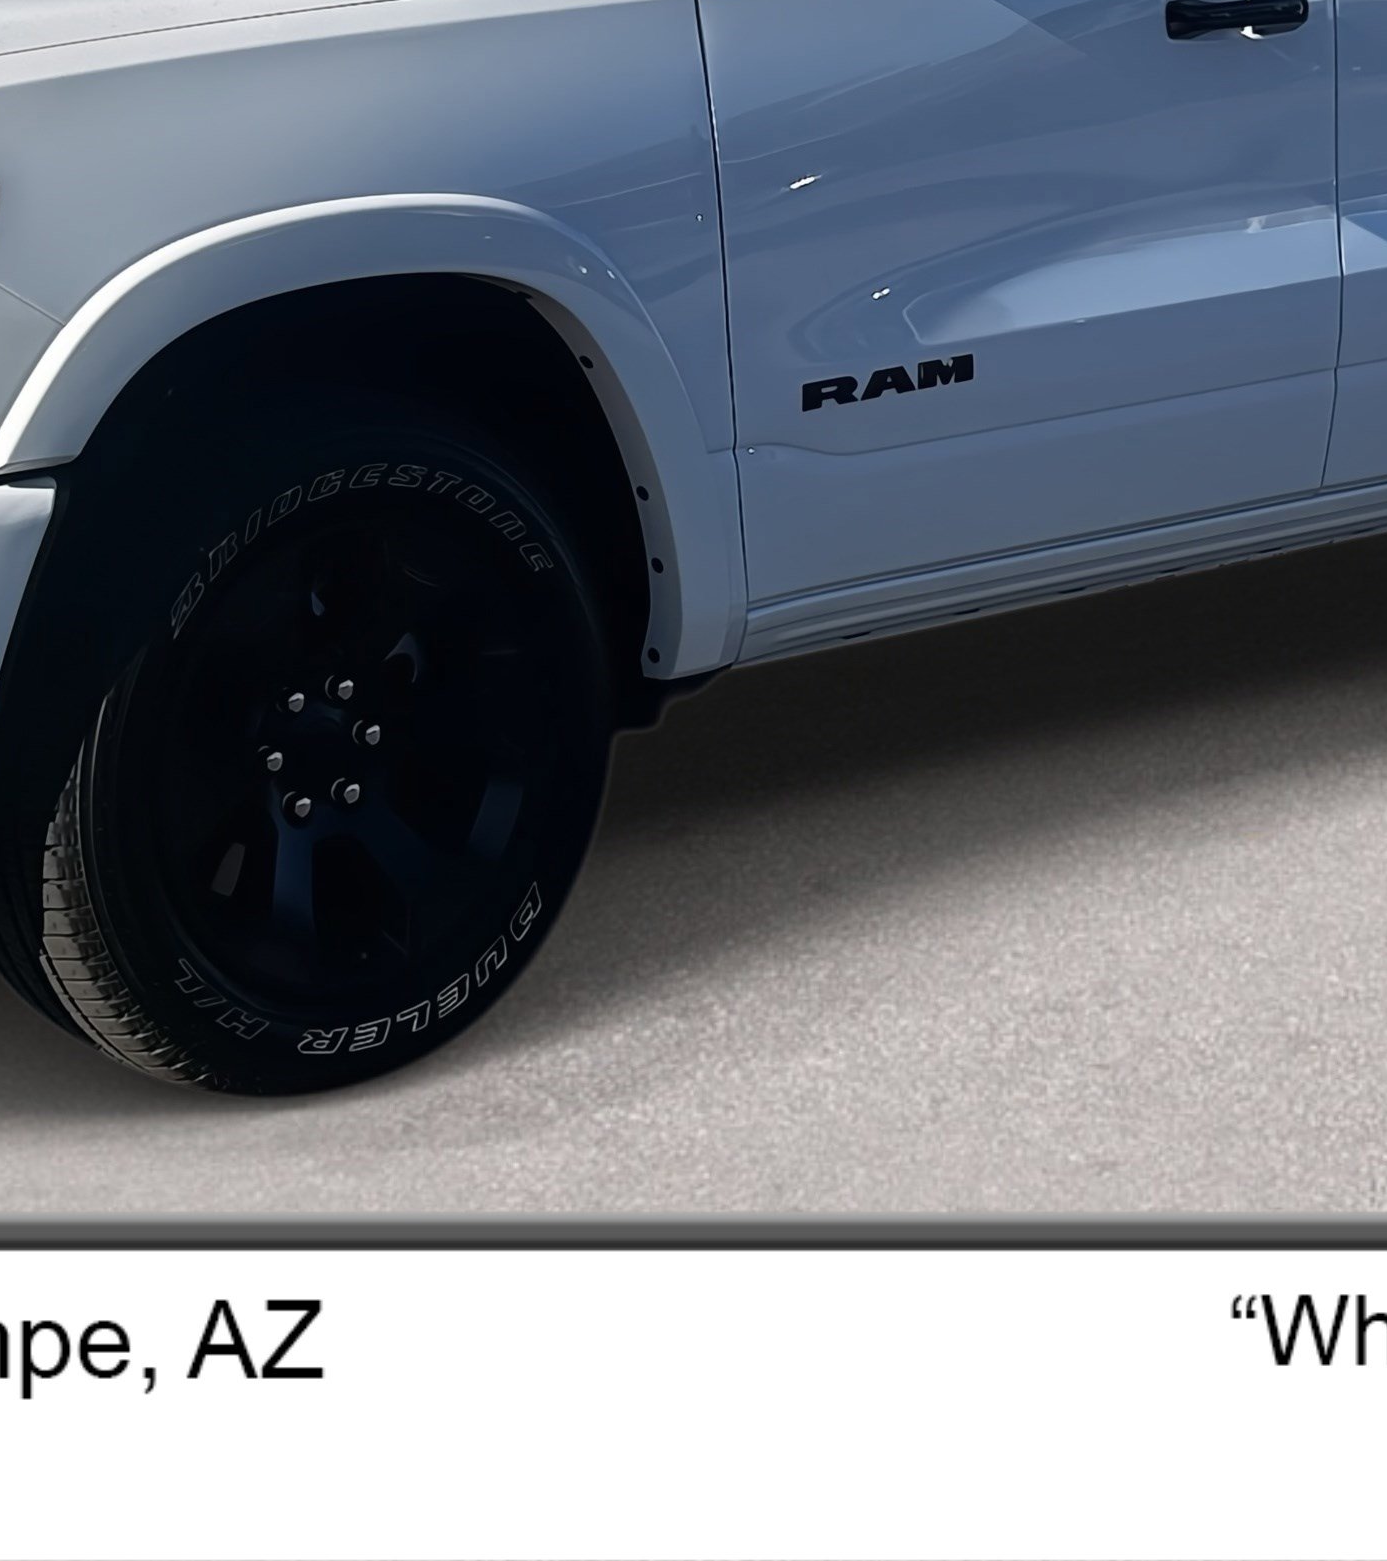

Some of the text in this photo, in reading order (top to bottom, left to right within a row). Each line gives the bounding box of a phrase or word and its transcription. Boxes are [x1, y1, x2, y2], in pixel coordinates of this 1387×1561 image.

[802, 344, 974, 412] RAM
[171, 463, 555, 641] BRIDGESTONE
[298, 881, 543, 1055] DUELER
